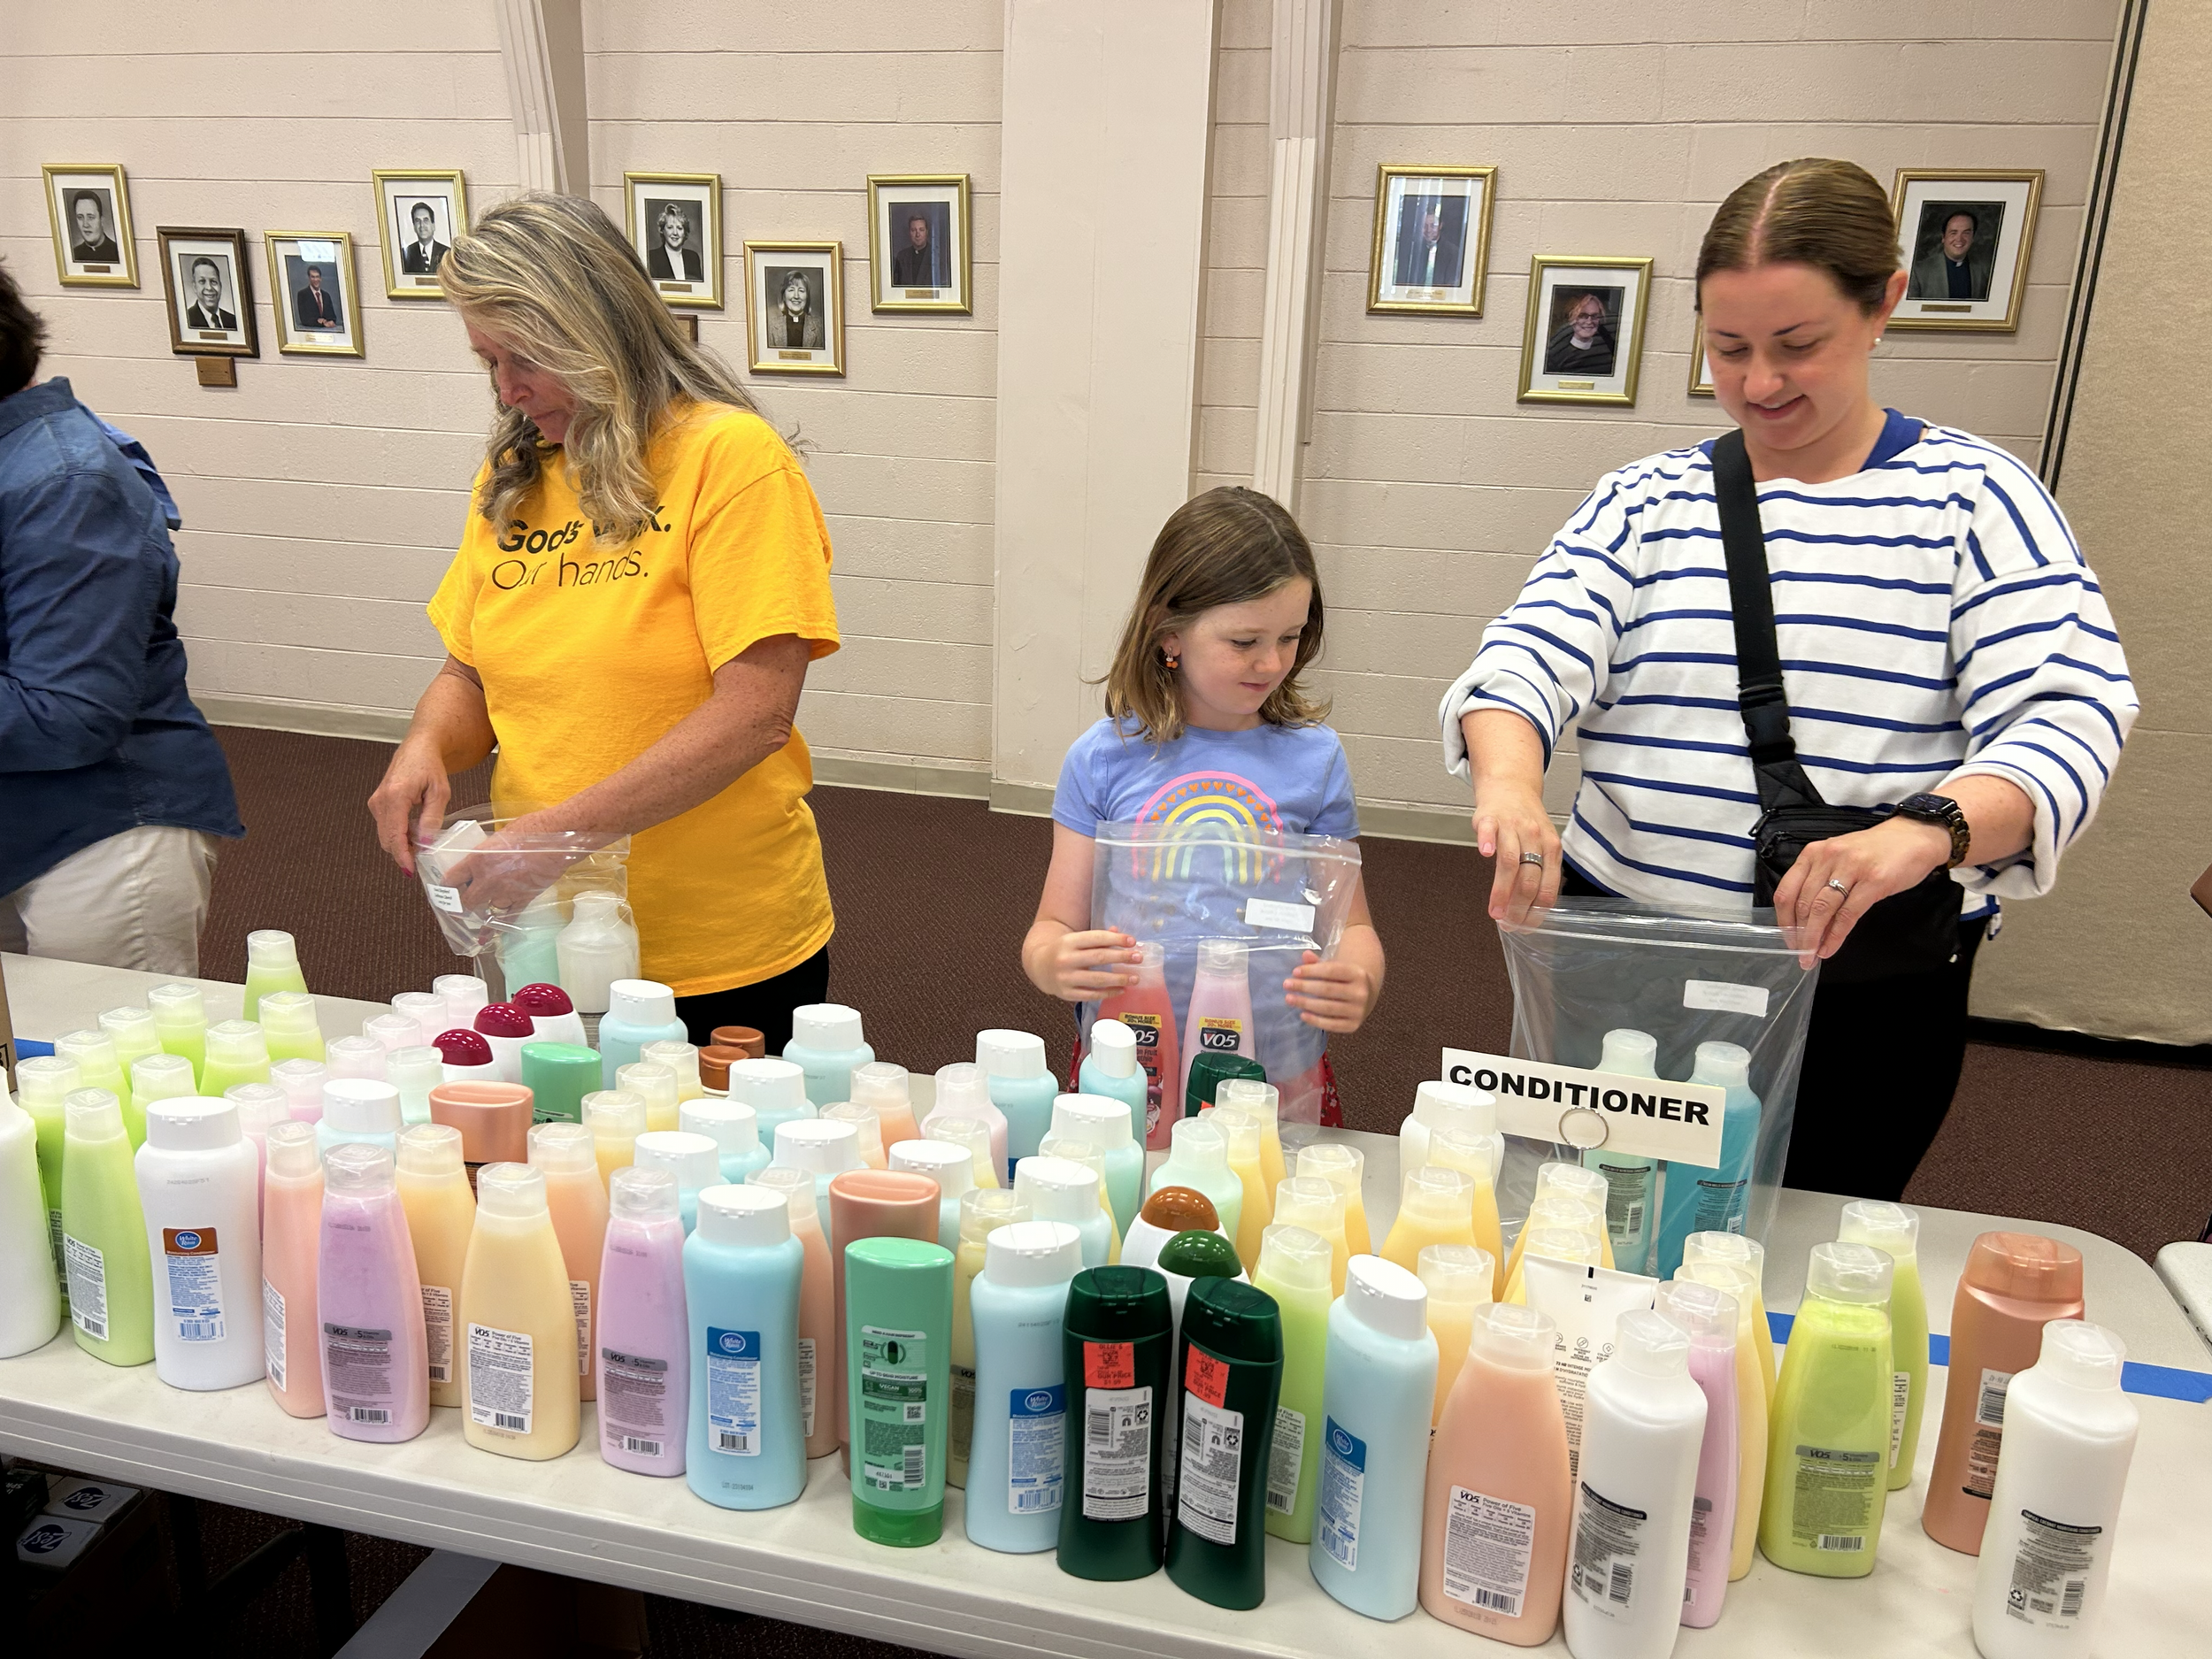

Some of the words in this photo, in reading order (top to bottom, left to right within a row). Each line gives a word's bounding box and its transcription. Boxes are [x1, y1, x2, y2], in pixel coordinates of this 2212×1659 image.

[592, 505, 672, 541] Wk.
[558, 547, 649, 588] hands.
[1134, 1029, 1156, 1044] O5
[1203, 1033, 1237, 1048] VO5
[1449, 1064, 1709, 1125] CONDITIONER
[332, 1327, 348, 1336] VO5
[474, 1327, 490, 1337] VO5
[611, 1351, 626, 1363] VO5
[1560, 1368, 1589, 1378] D'HYDRATATIO
[1204, 1386, 1221, 1398] PRICE
[1809, 1449, 1832, 1459] VO5
[62, 1491, 111, 1508] Zest
[1460, 1491, 1480, 1504] VO5
[1483, 1497, 1501, 1507] Power
[2024, 1510, 2039, 1522] TROPICAL
[19, 1531, 72, 1549] Zest
